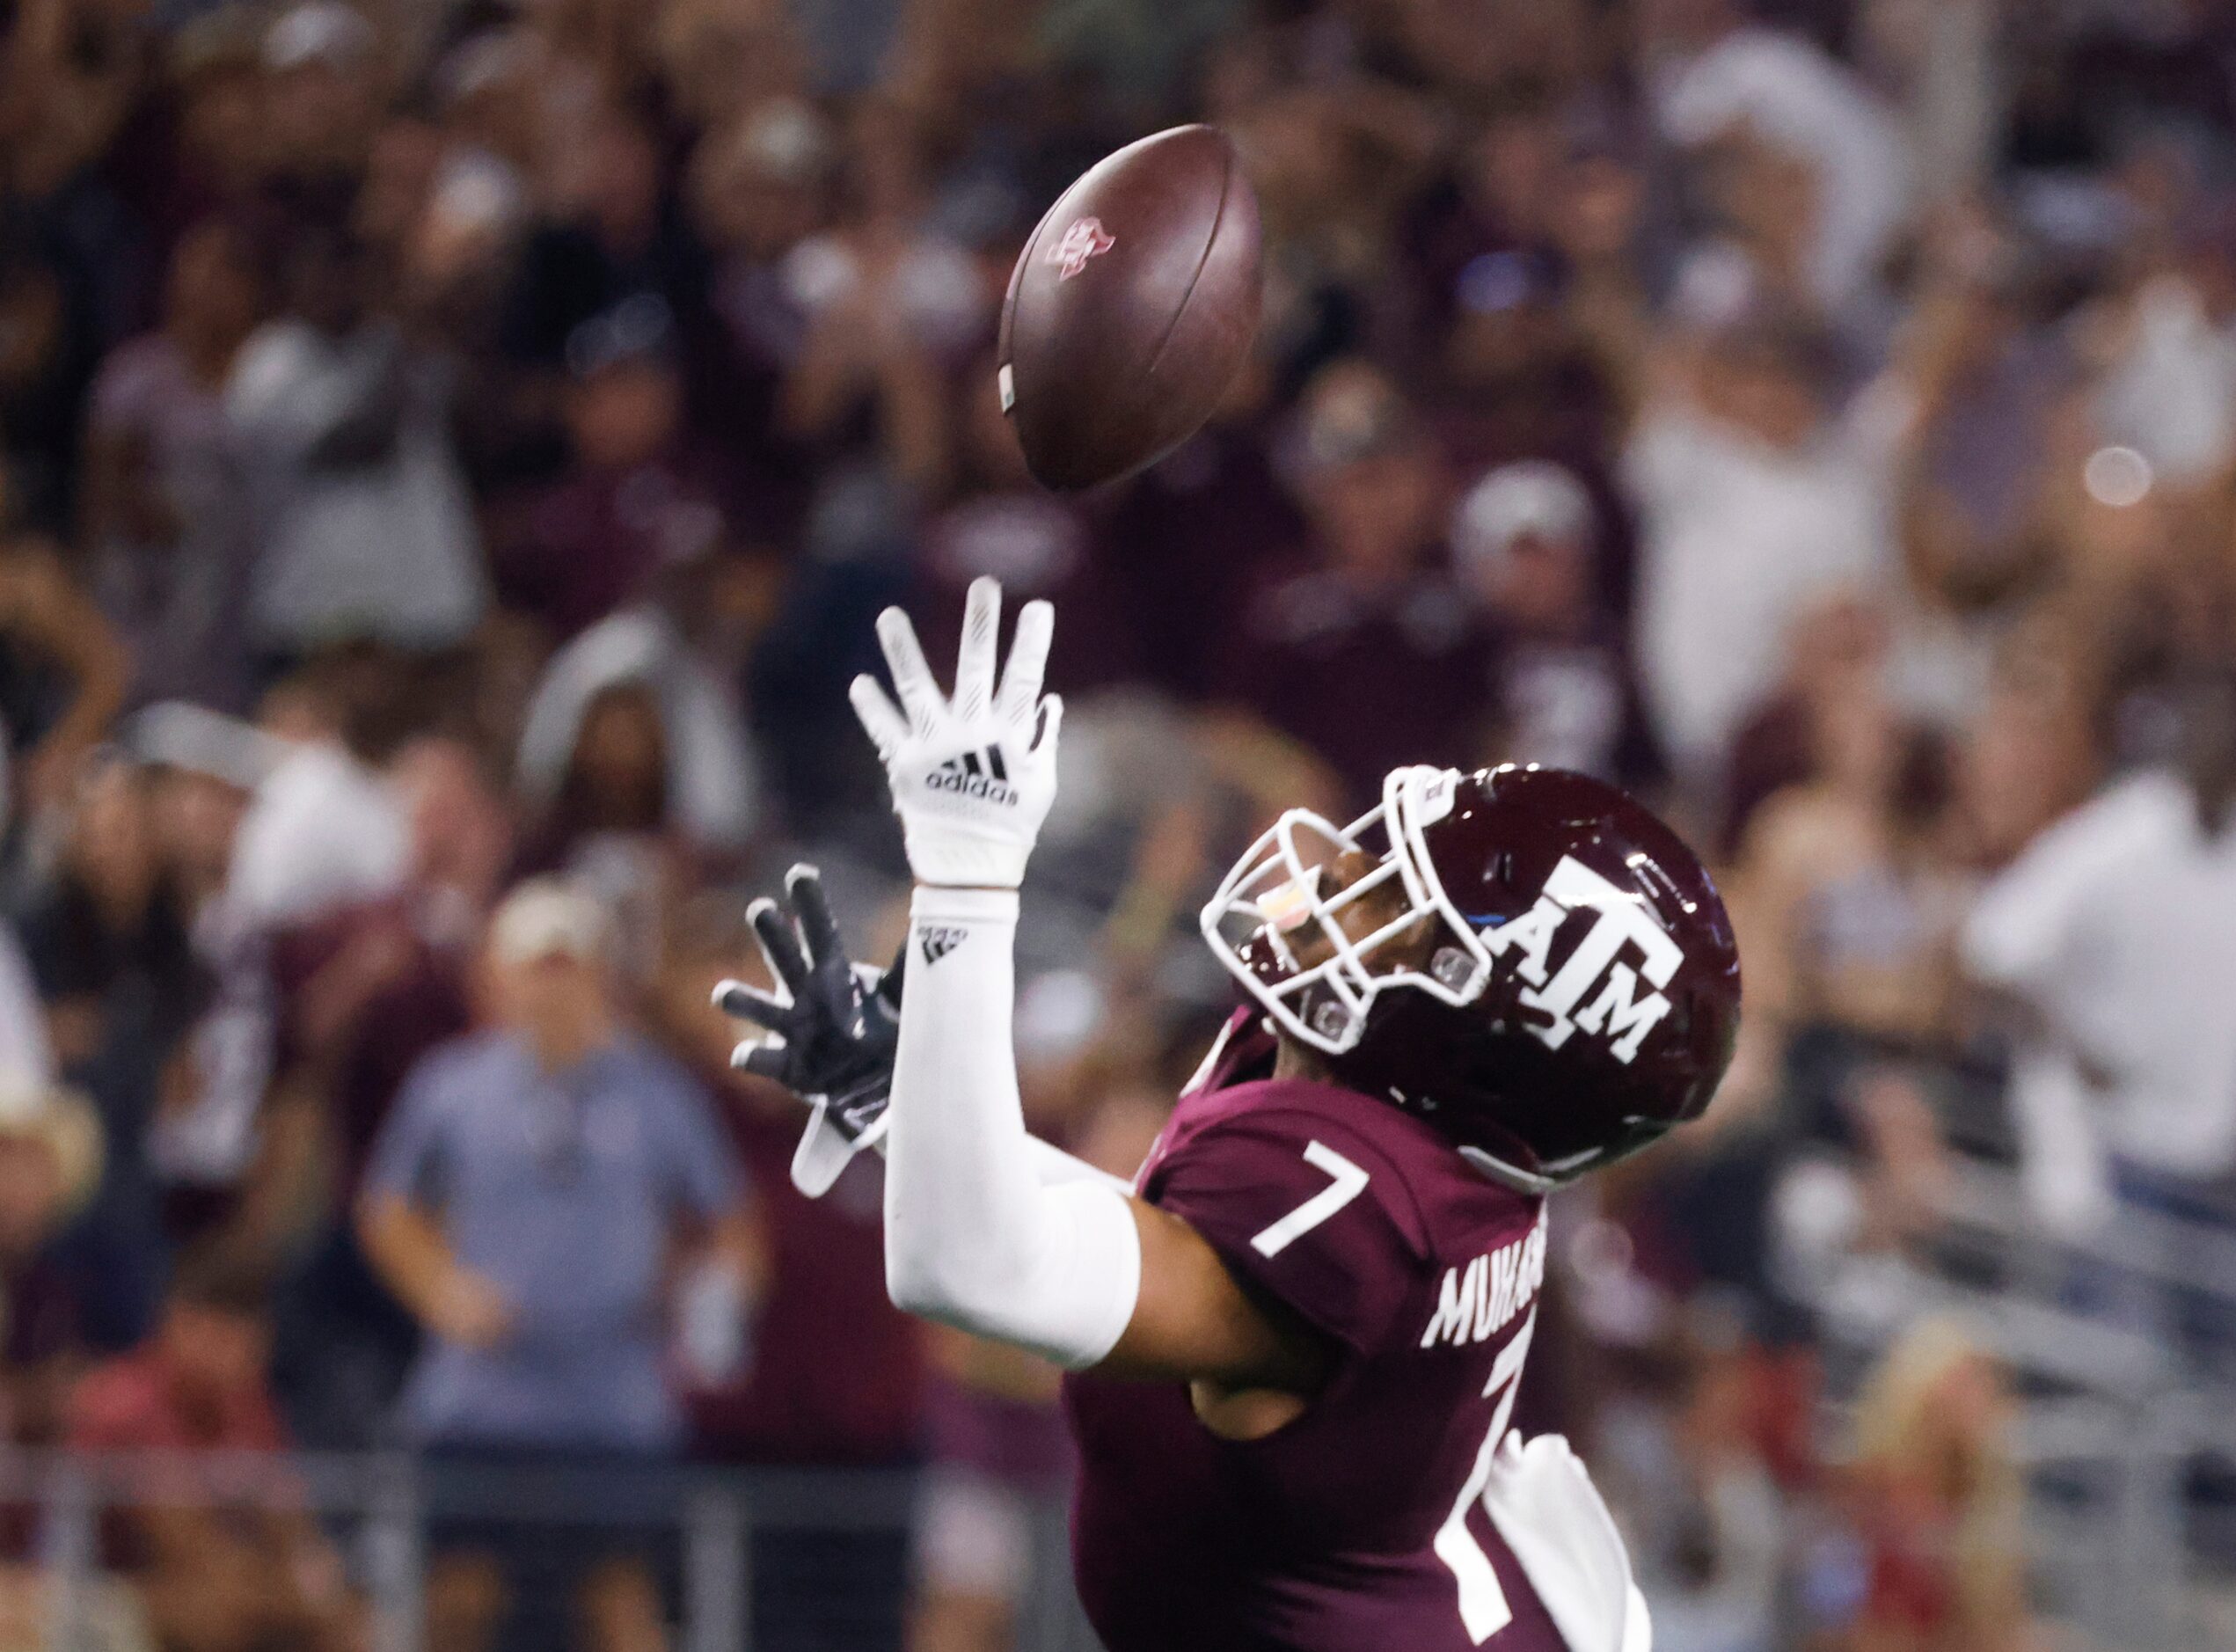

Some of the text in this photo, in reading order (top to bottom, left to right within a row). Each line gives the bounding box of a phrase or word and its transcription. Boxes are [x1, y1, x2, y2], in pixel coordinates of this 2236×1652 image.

[926, 772, 1019, 807] adidas
[1250, 1140, 1370, 1259] 7
[1433, 1303, 1538, 1646] 7
